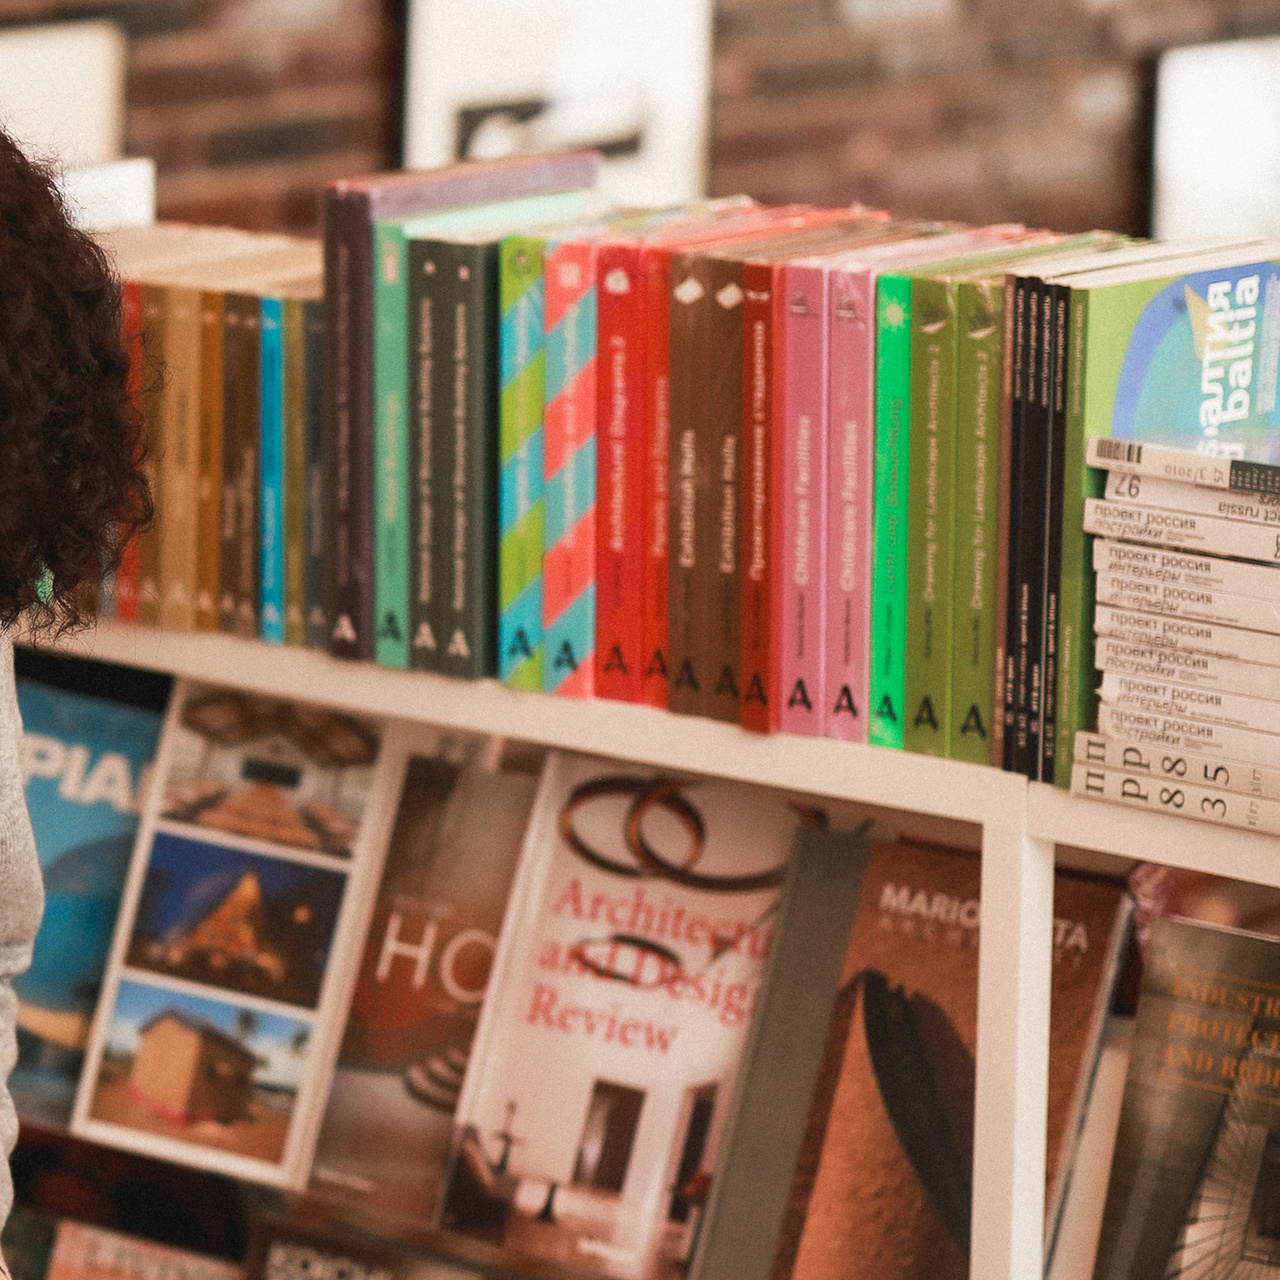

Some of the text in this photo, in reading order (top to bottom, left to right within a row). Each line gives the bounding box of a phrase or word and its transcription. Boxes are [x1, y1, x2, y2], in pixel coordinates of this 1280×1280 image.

[1219, 274, 1261, 422] baltia
[924, 436, 940, 515] Landscape
[971, 444, 987, 521] Landscape
[1114, 474, 1141, 498] 97
[793, 415, 811, 586] Childcare Facilities
[839, 420, 858, 591] Childcare Facilities
[1218, 501, 1260, 520] russia
[923, 518, 937, 540] for
[1094, 504, 1197, 531] проект россия
[971, 525, 985, 546] for
[922, 543, 938, 603] Drawing
[1109, 546, 1212, 574] проект россия
[969, 549, 986, 610] Drawing
[1111, 577, 1213, 605] проект россия
[1111, 611, 1213, 640] проект россия
[1106, 641, 1209, 669] проект россия
[1119, 677, 1223, 707] проект россия
[1111, 710, 1214, 739] проект россия
[879, 882, 980, 928] MARIO
[527, 982, 680, 1054] Review
